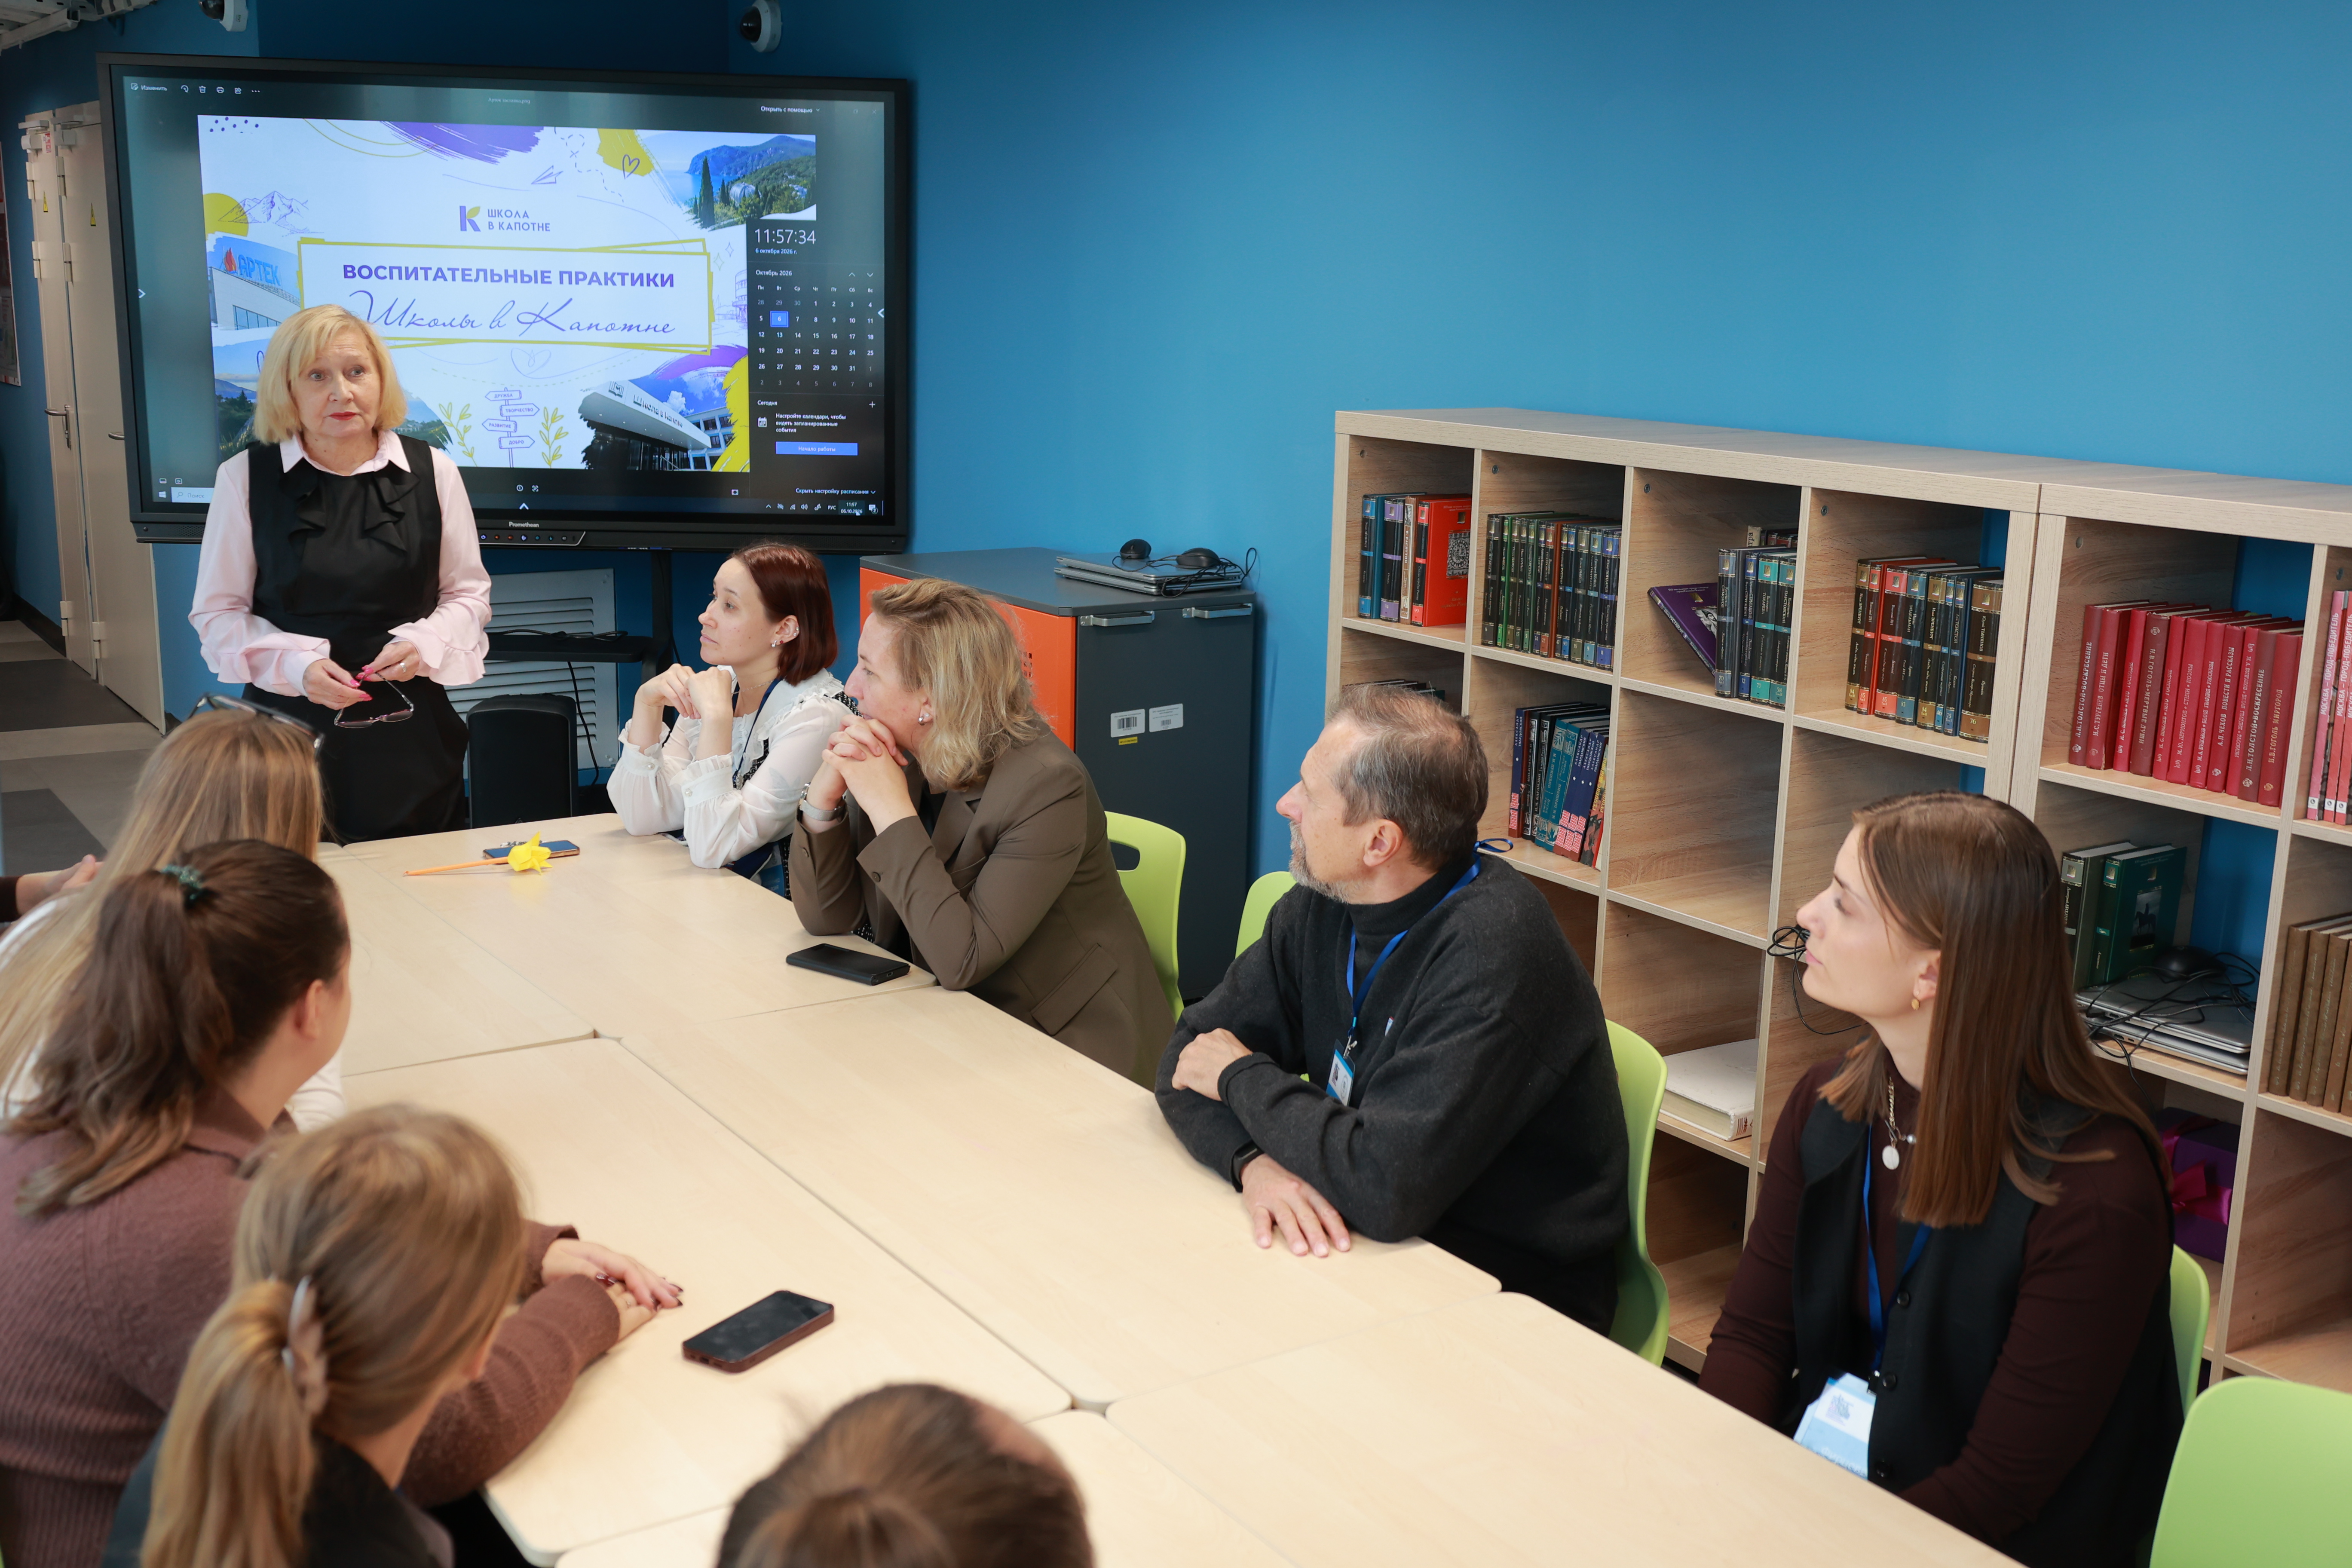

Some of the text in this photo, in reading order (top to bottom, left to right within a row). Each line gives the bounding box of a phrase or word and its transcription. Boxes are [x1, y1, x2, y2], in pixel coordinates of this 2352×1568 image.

[760, 106, 782, 114] Открыть
[488, 209, 529, 218] ШКОЛА
[488, 221, 550, 231] В КАПОТНЕ
[755, 229, 816, 244] 11:57:34
[238, 254, 281, 287] АРТЕК
[343, 264, 674, 287] ВОСПИТАТЕЛЬНЫЕ ПРАКТИКИ
[349, 290, 675, 337] Школы в Капотне
[2081, 642, 2092, 690] ВОСКРЕСЕНИЕ
[2146, 649, 2156, 688] Н.В.ГОГОЛЬ
[2226, 647, 2235, 677] РАССКАЗЫ
[2320, 613, 2339, 715] МОСКВА ГОРОД-ПОБЕДИТЕЛЬ
[2337, 614, 2352, 717] МОСКВА ГОРОД-ПОБЕДИТЕЛЬ
[2141, 692, 2150, 723] МЕРТВЫЕ
[2221, 684, 2231, 710] ПОВЕСТИ
[2252, 669, 2265, 721] ВОСКРЕСЕНИЕ
[2272, 689, 2283, 724] МИРГОРОД
[2217, 714, 2226, 747] А.П.ЧЕХОВ
[1574, 735, 1583, 766] АЛЕКСАНДР
[1578, 737, 1586, 767] ТВАРДОВСКИЙ
[1583, 738, 1592, 769] АЛЕКСАНДР
[1586, 741, 1595, 771] ТВАРДОВСКИЙ
[1590, 740, 1599, 770] АЛЕКСАНДР
[1594, 742, 1602, 772] ТВАРДОВСКИЙ
